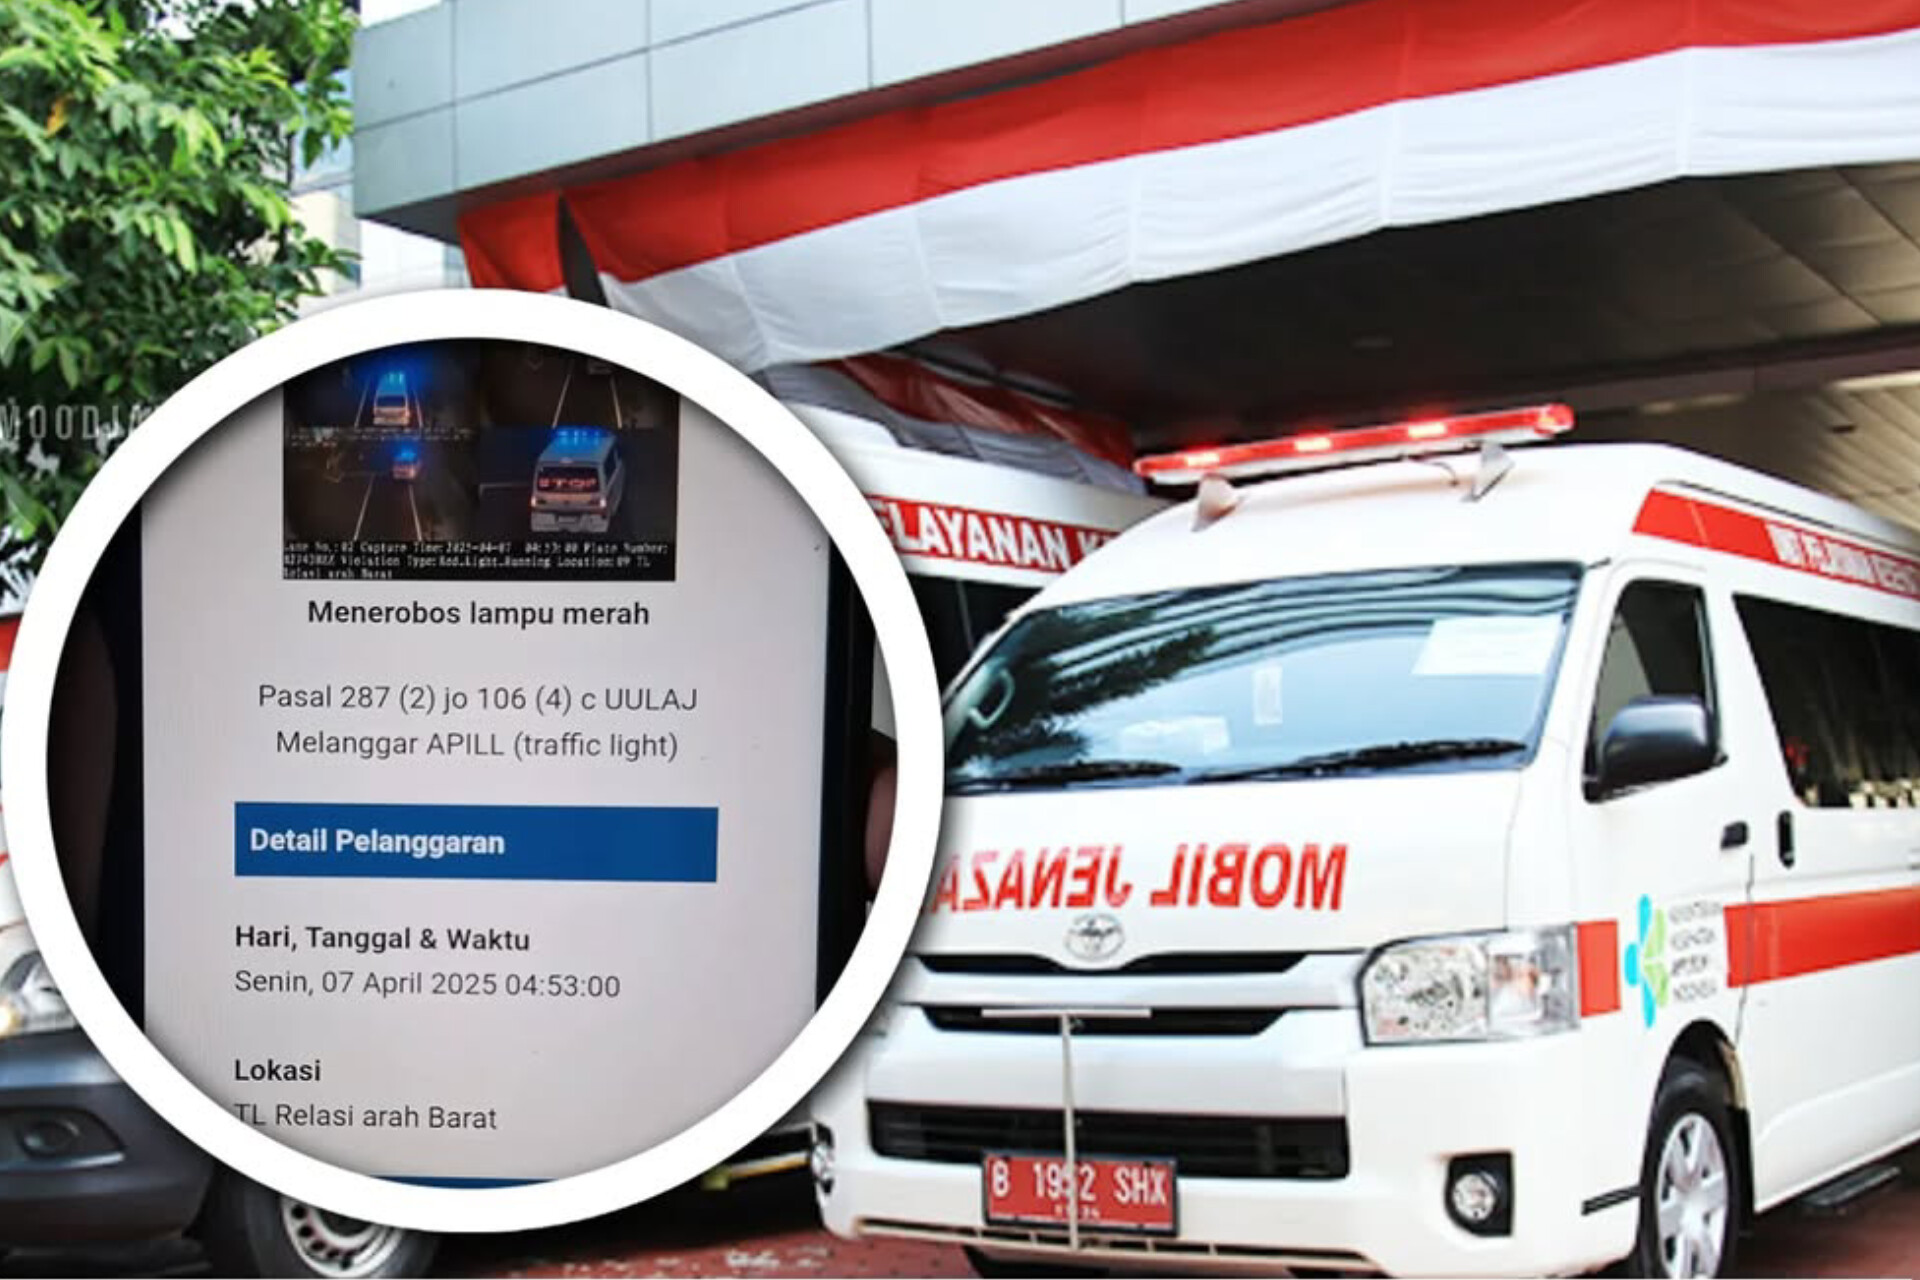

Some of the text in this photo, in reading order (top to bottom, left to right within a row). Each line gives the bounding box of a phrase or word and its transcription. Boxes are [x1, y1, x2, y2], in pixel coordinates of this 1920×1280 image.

[308, 600, 649, 631] Menerobos lampu merah
[259, 684, 698, 717] Pasal 287 (2) jo 106 (4) c UULAJ
[276, 730, 678, 763] Melanggar APILL (traffic light)
[250, 828, 506, 858] Detail Pelanggaran
[236, 925, 530, 954] Hari, Tanggal & Waktu
[235, 970, 621, 999] Senin, 07 April 2025 04:53:00
[235, 1058, 321, 1081] Lokasi
[235, 1104, 497, 1130] TL Relasi arah Barat
[991, 1160, 1010, 1198] B
[1113, 1167, 1168, 1206] SHX
